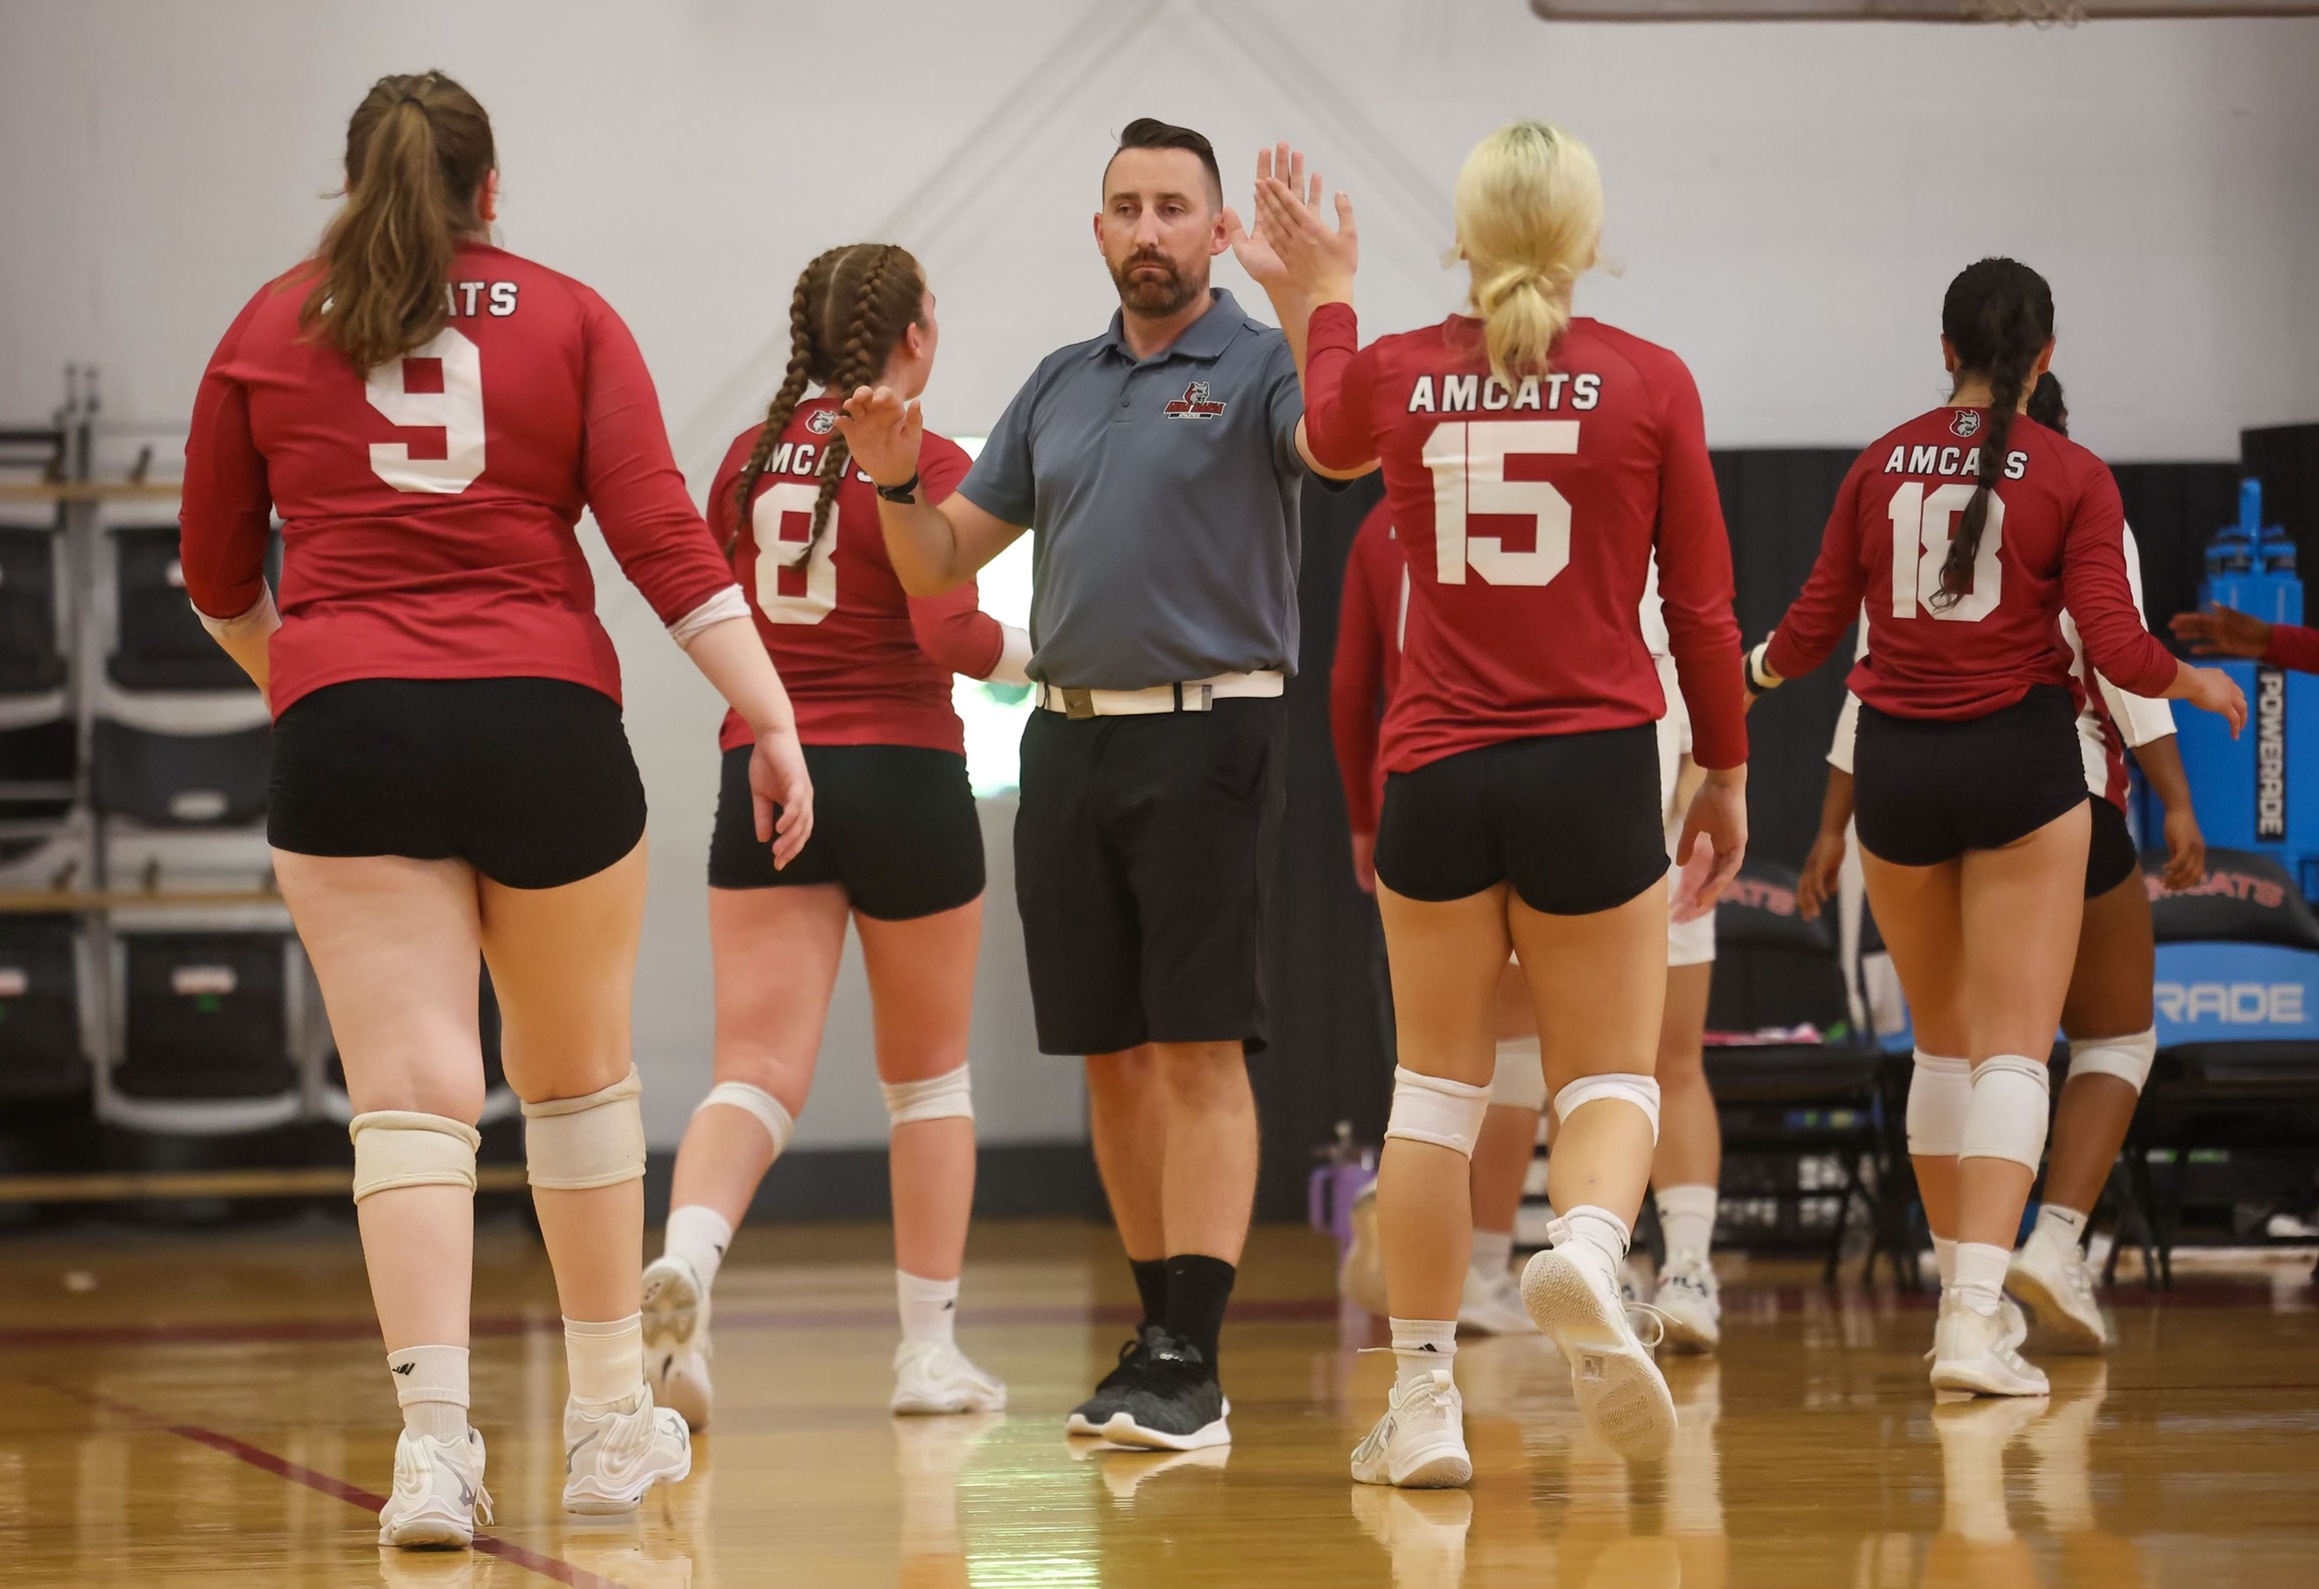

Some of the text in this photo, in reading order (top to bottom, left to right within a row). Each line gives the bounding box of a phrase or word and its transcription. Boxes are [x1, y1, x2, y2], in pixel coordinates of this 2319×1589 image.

[365, 327, 486, 494] 9
[1407, 373, 1602, 413] AMCATS
[1883, 445, 2028, 481] AMCAS
[752, 482, 840, 626] 8
[1421, 420, 1580, 587] 15
[1888, 481, 2006, 623] 18
[2259, 671, 2284, 836] POWERADE
[2153, 982, 2304, 1024] RADE
